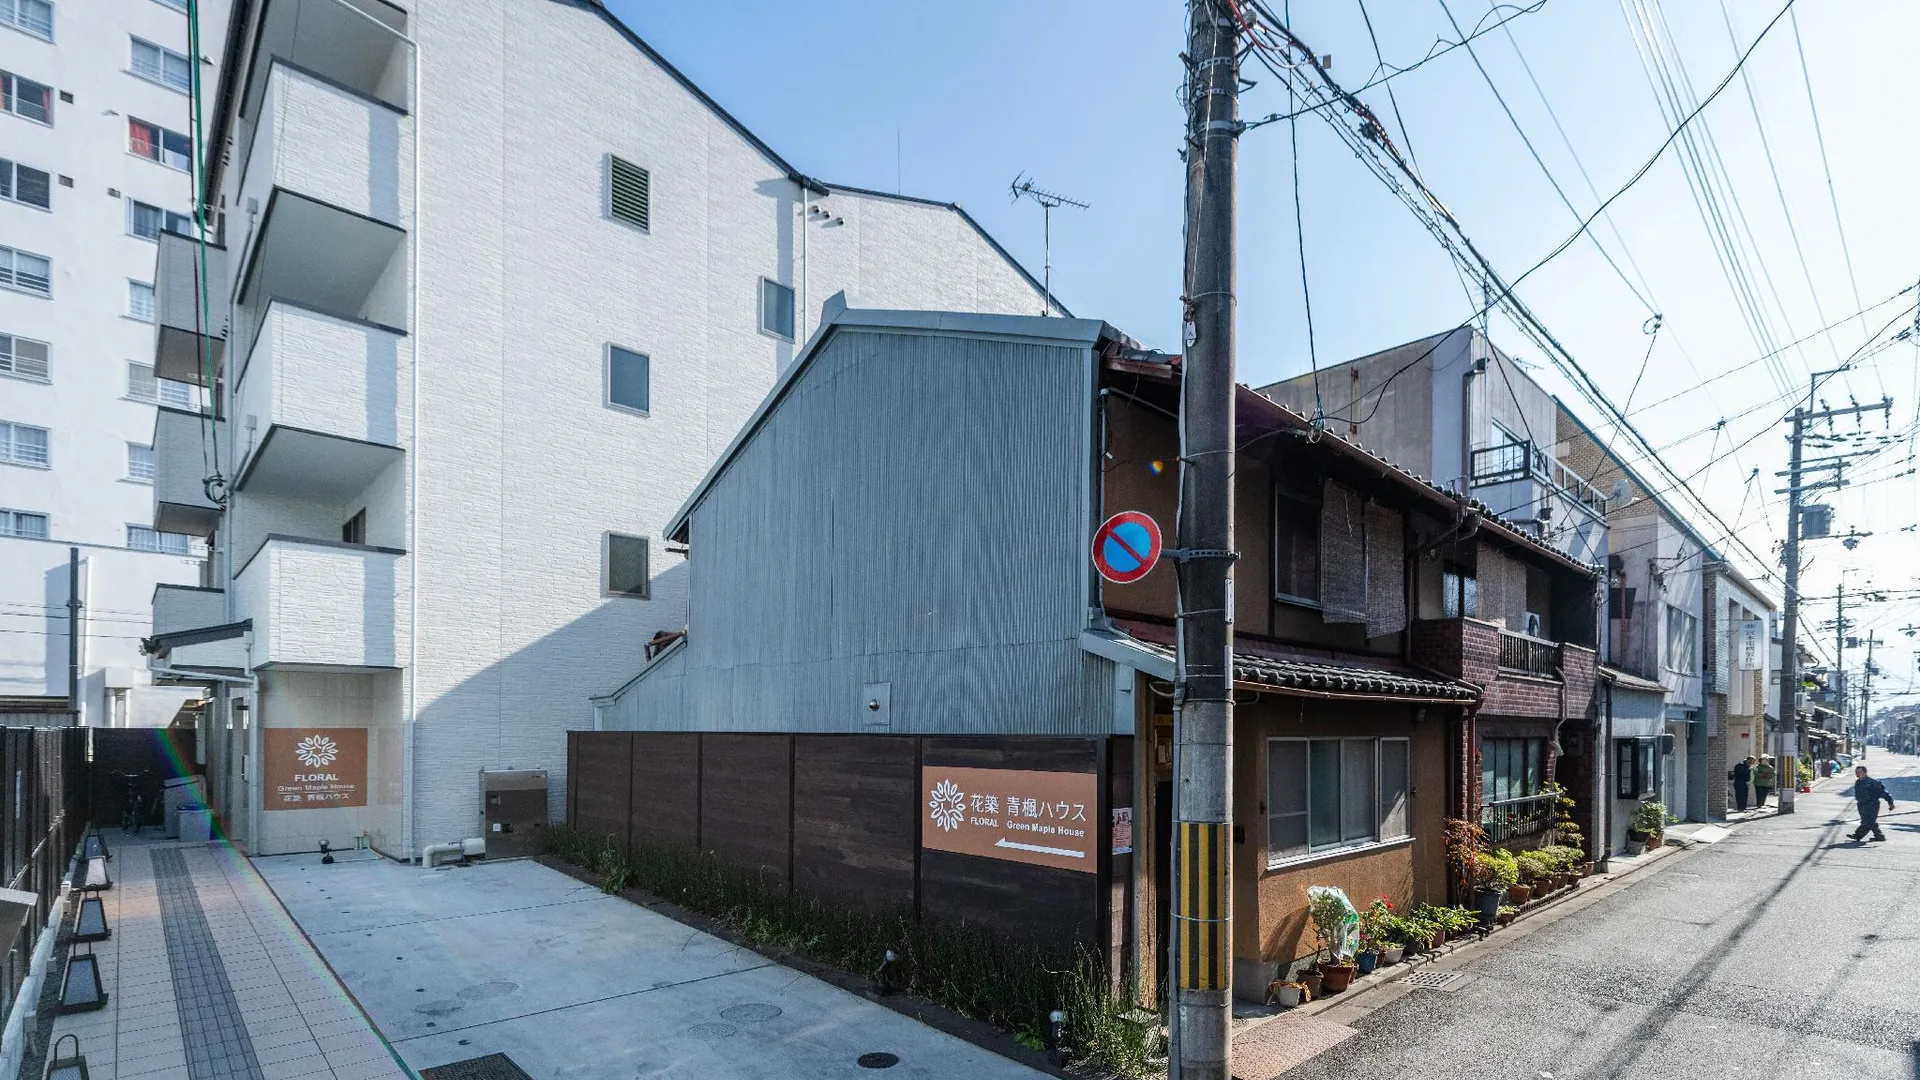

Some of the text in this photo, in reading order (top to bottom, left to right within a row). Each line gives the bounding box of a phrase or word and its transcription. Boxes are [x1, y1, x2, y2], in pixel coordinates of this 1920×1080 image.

[294, 773, 339, 782] FLORAL
[970, 793, 1086, 822] 花築 青楓ハウス
[970, 817, 1085, 837] FLORAL Green Maple House
